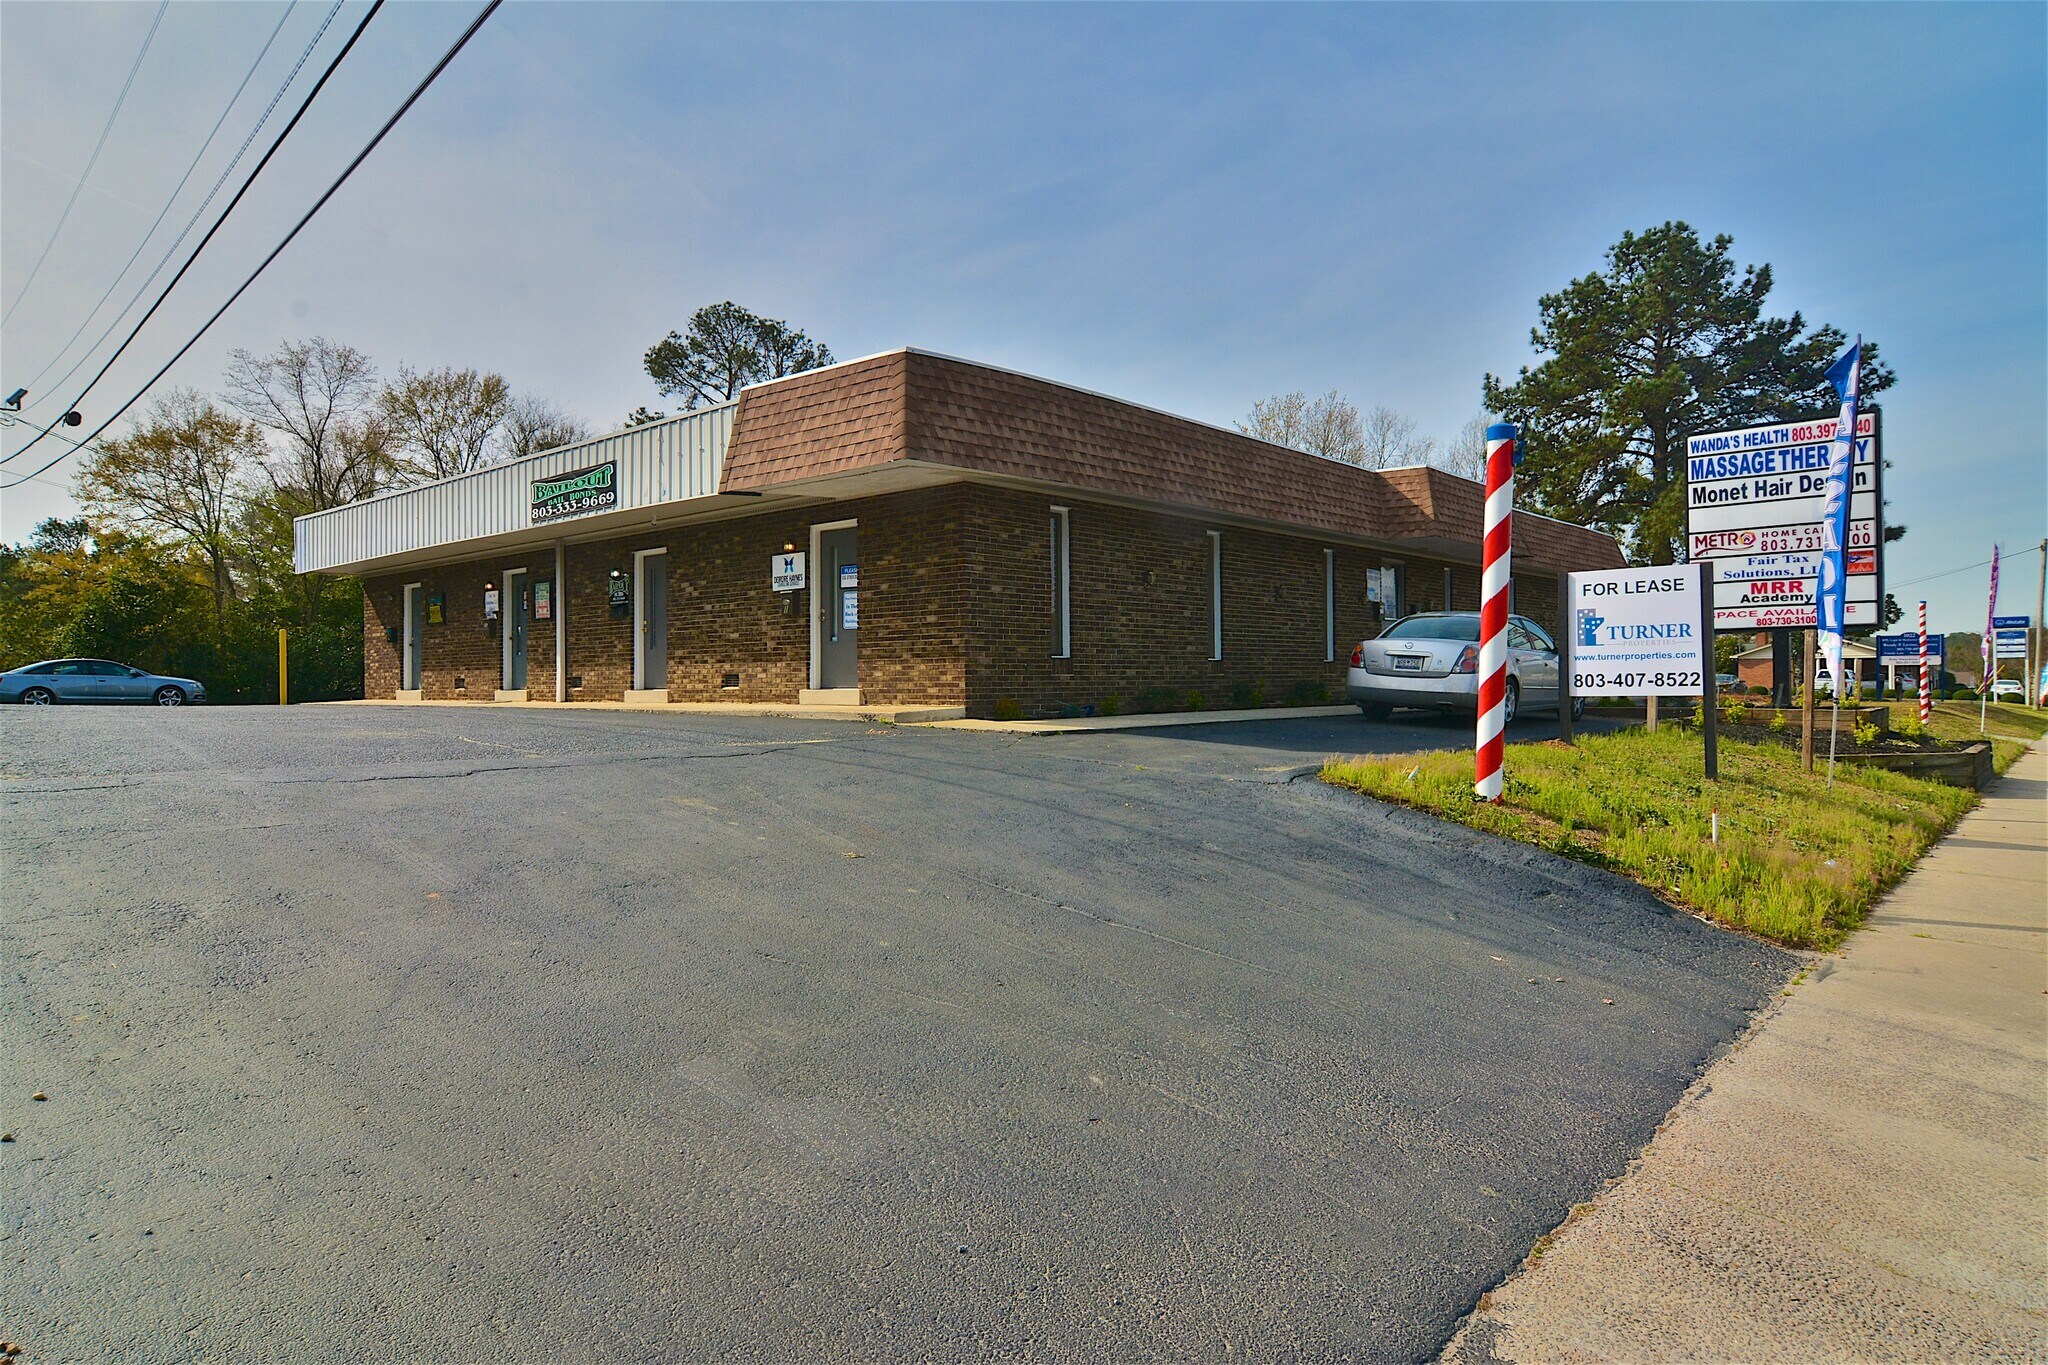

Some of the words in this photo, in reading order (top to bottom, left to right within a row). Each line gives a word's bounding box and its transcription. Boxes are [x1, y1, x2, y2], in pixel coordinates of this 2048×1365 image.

[1690, 435, 1740, 454] WANDA'S
[1743, 428, 1789, 447] HEALTH
[1791, 418, 1871, 442] 803.39740
[1691, 450, 1775, 481] MASSAGE
[1779, 440, 1869, 471] THERY
[532, 464, 613, 504] BAILOUT
[1692, 482, 1748, 505] Monet
[1755, 478, 1793, 498] Hair
[532, 491, 615, 519] 803-333-9669
[547, 495, 565, 506] BAIL
[569, 489, 598, 501] BONDS
[1761, 529, 1798, 539] HOME
[1761, 532, 1871, 552] 803.73100
[1748, 556, 1778, 566] Fair
[1782, 554, 1810, 564] Tax
[1723, 566, 1795, 580] Solutions,
[1800, 565, 1819, 576] LL
[1582, 581, 1619, 597] FOR
[1624, 578, 1685, 595] LEASE
[1750, 580, 1804, 595] MRR
[1740, 593, 1814, 604] Academy
[1713, 608, 1759, 619] PACE
[1764, 605, 1857, 617] AVAILAE
[1756, 615, 1817, 626] 803-730-3100
[1606, 623, 1693, 641] TURNER
[1622, 639, 1677, 647] PROPERTIES
[1573, 651, 1697, 662] www.turnerproperties.com
[1573, 672, 1701, 688] 803-407-8522
